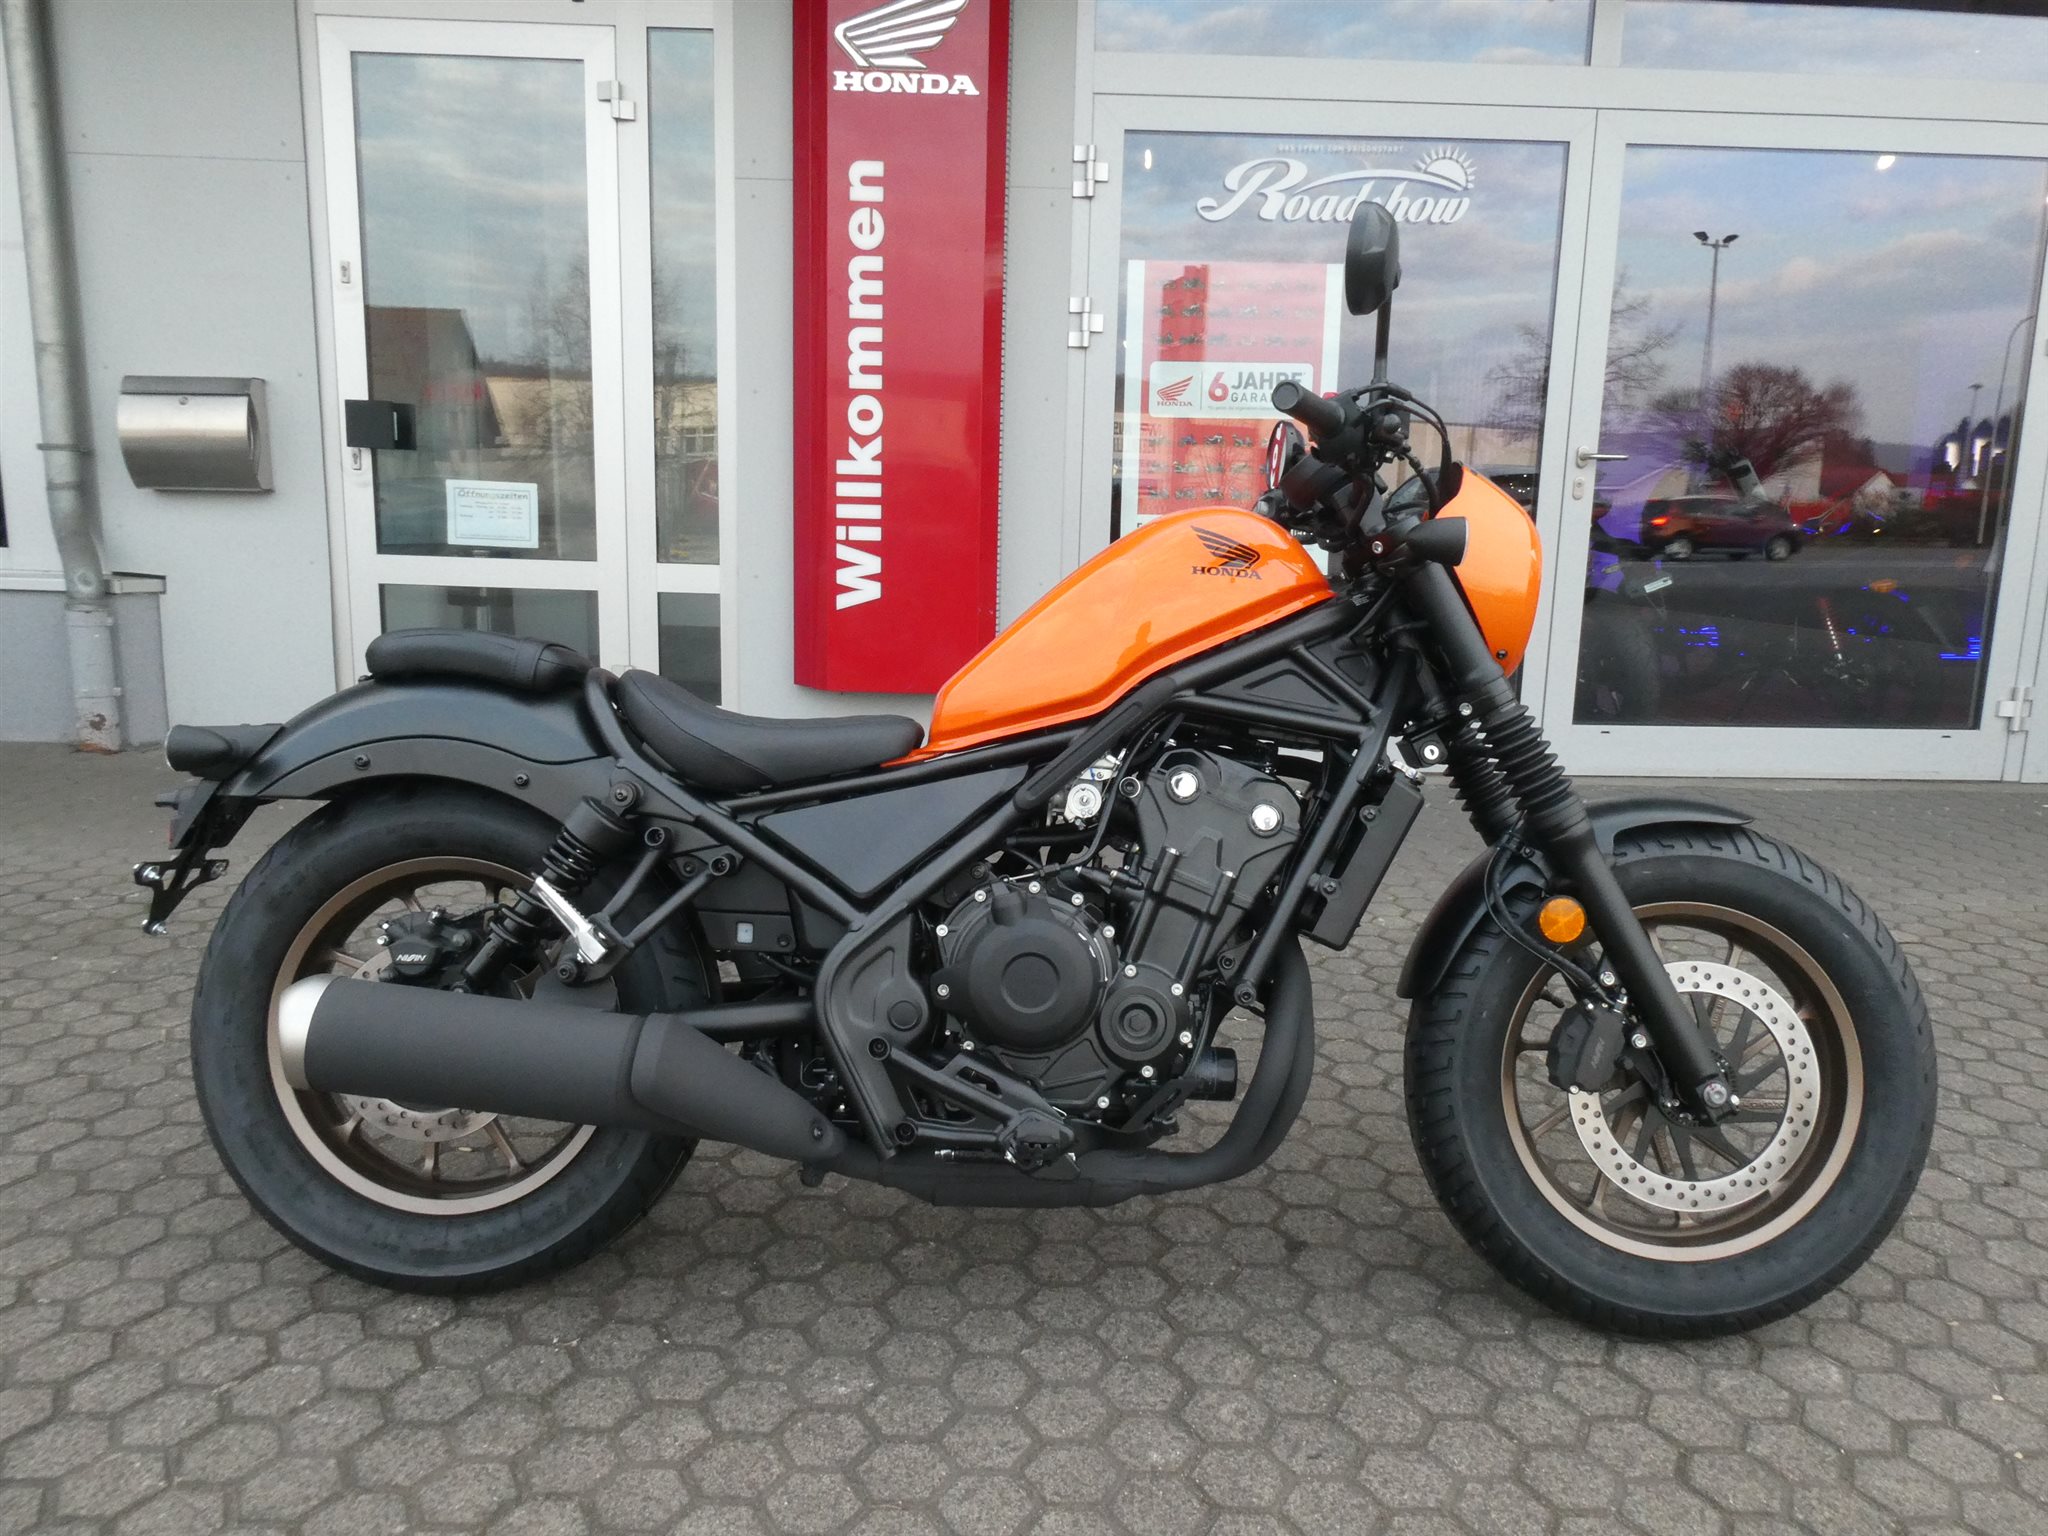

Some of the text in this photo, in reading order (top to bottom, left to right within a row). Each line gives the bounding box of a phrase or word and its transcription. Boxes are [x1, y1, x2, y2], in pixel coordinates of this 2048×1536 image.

[833, 70, 980, 96] HONDA
[1196, 157, 1471, 225] Roadhow
[835, 159, 886, 611] Willkommen
[1208, 371, 1230, 402] 6
[1231, 392, 1272, 403] GARA
[457, 488, 529, 501] Öffnunszeiten
[1191, 565, 1263, 580] HONDA
